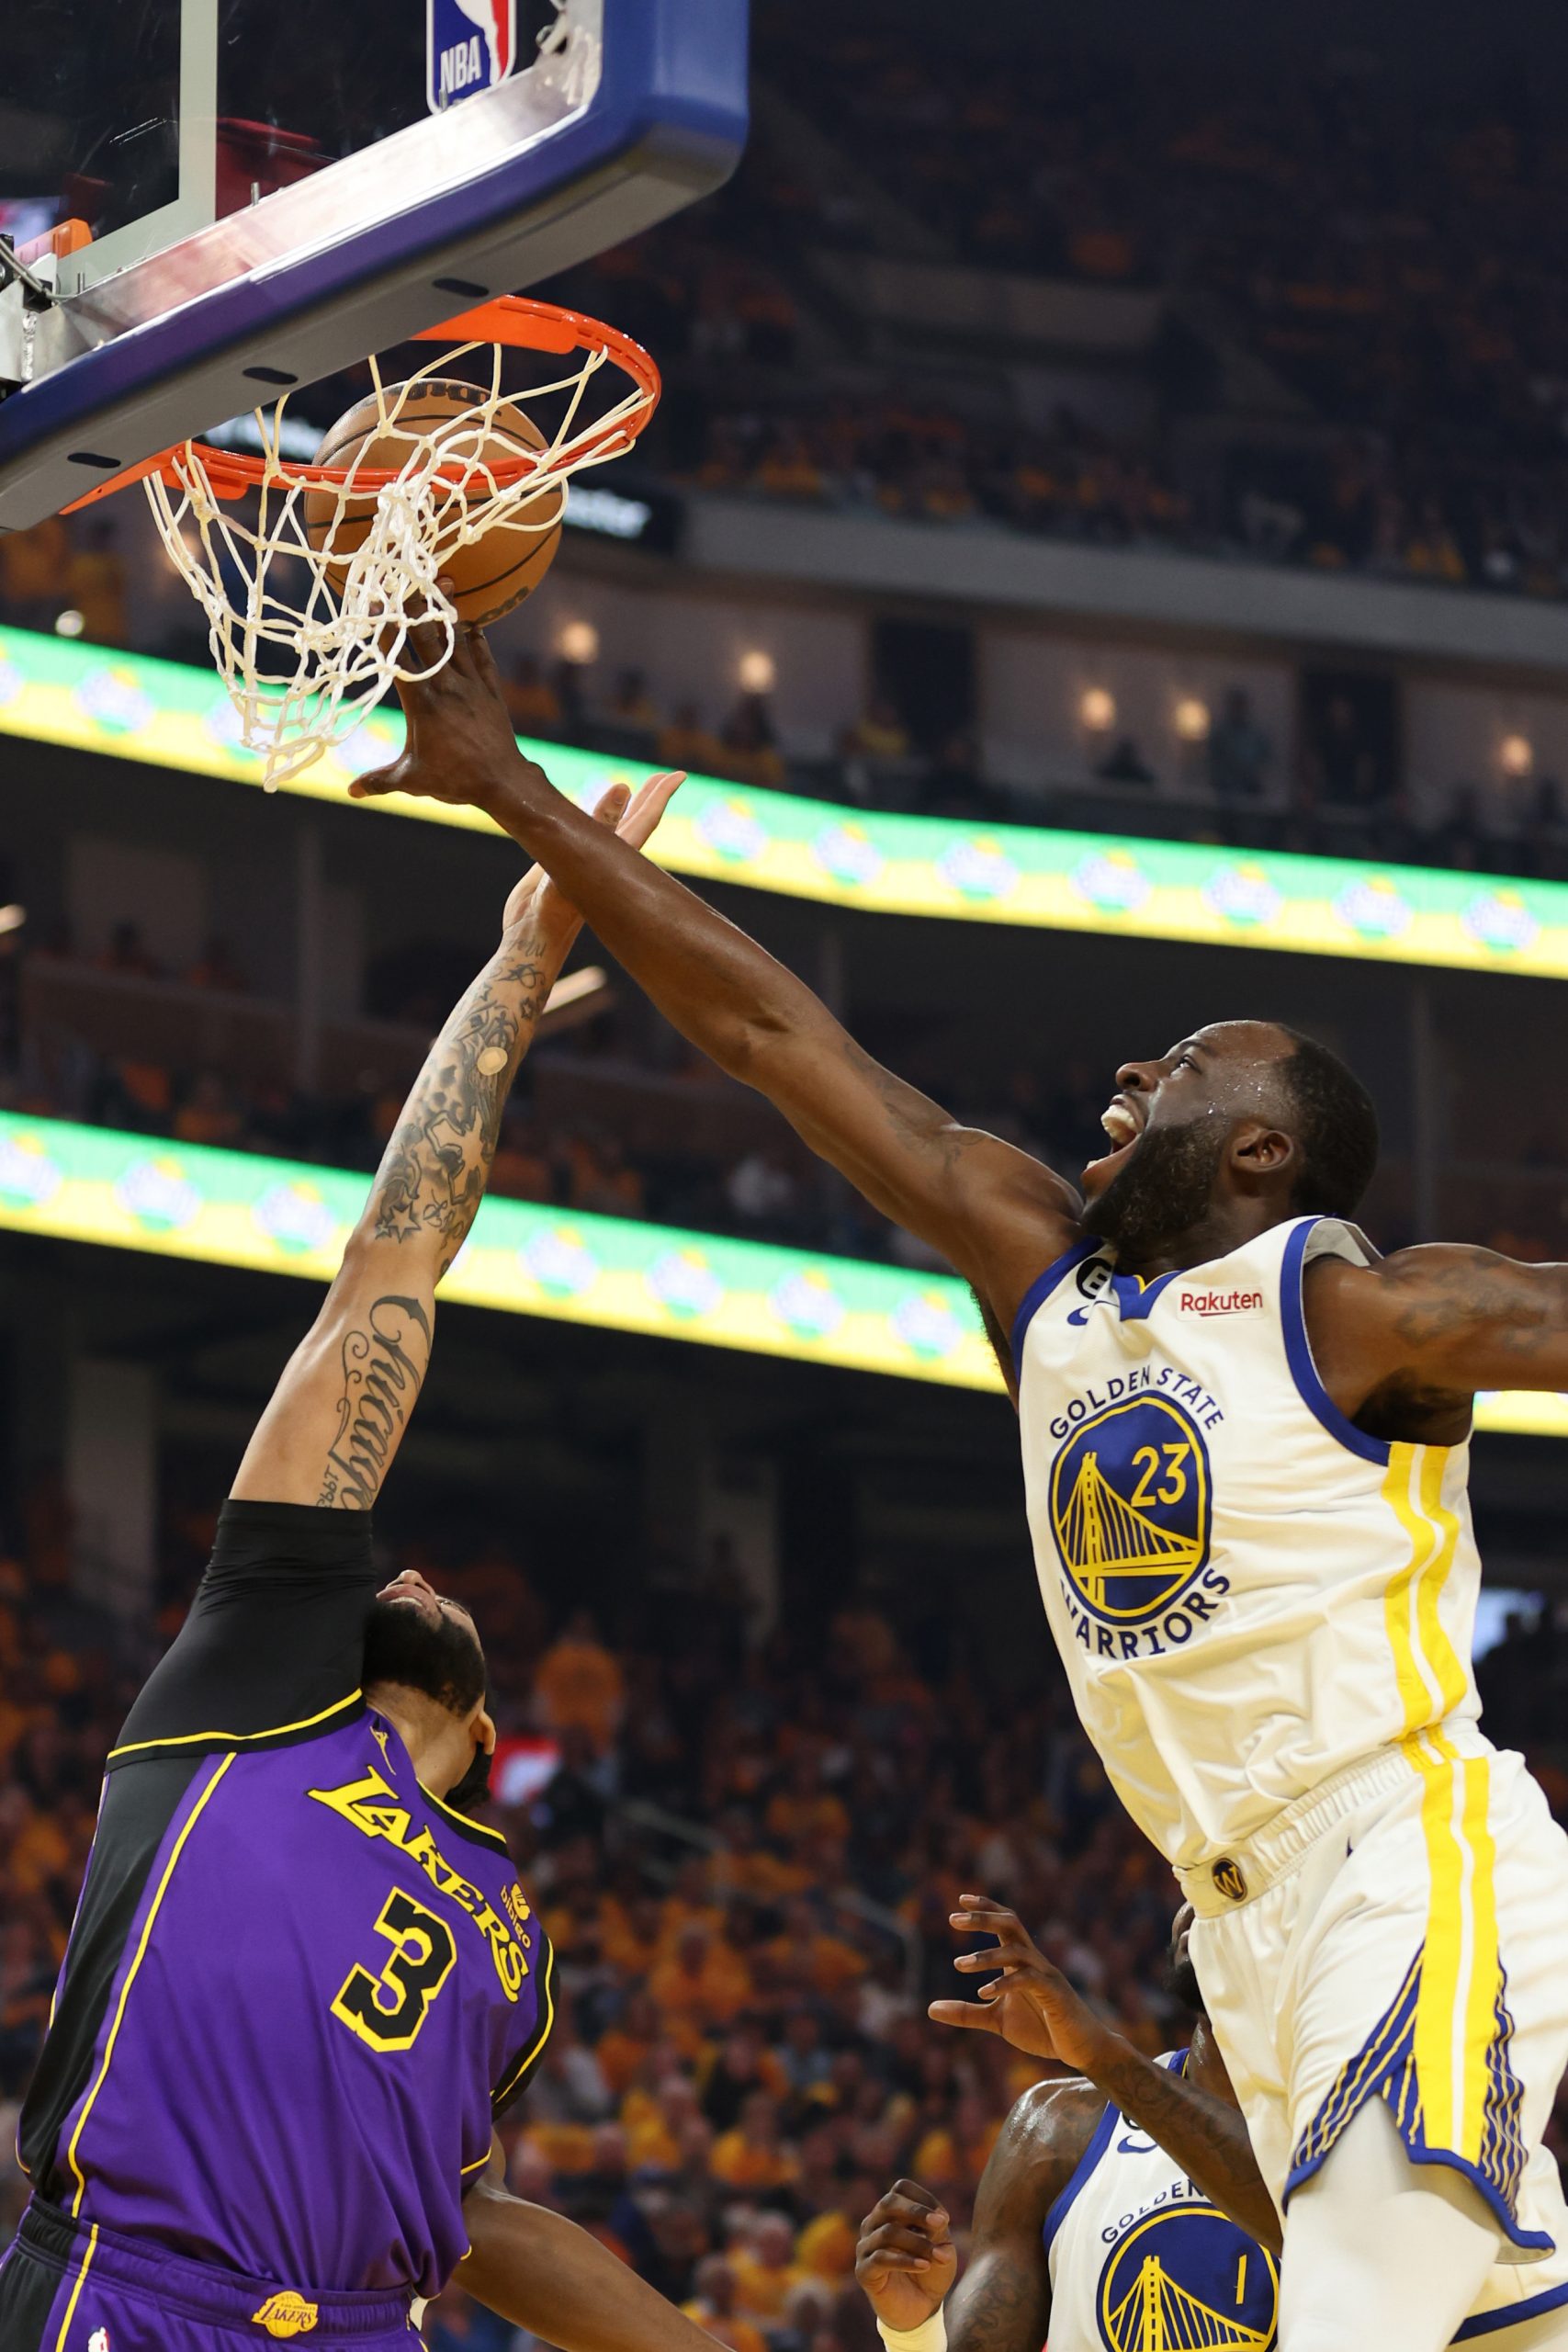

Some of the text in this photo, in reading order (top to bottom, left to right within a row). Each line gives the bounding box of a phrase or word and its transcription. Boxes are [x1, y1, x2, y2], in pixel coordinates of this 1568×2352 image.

[440, 34, 482, 94] NBA
[1181, 1291, 1263, 1312] Rakuten
[1049, 1364, 1224, 1440] GOLDEN STATE
[1131, 1442, 1190, 1508] 23
[307, 1764, 530, 2003] LAKERS
[1213, 1865, 1245, 1898] W
[500, 1884, 531, 1949] bibigo
[330, 1885, 457, 2052] 3
[1100, 2178, 1204, 2244] GOLDEN
[1235, 2254, 1247, 2305] 1
[259, 2301, 314, 2330] LAKERS
